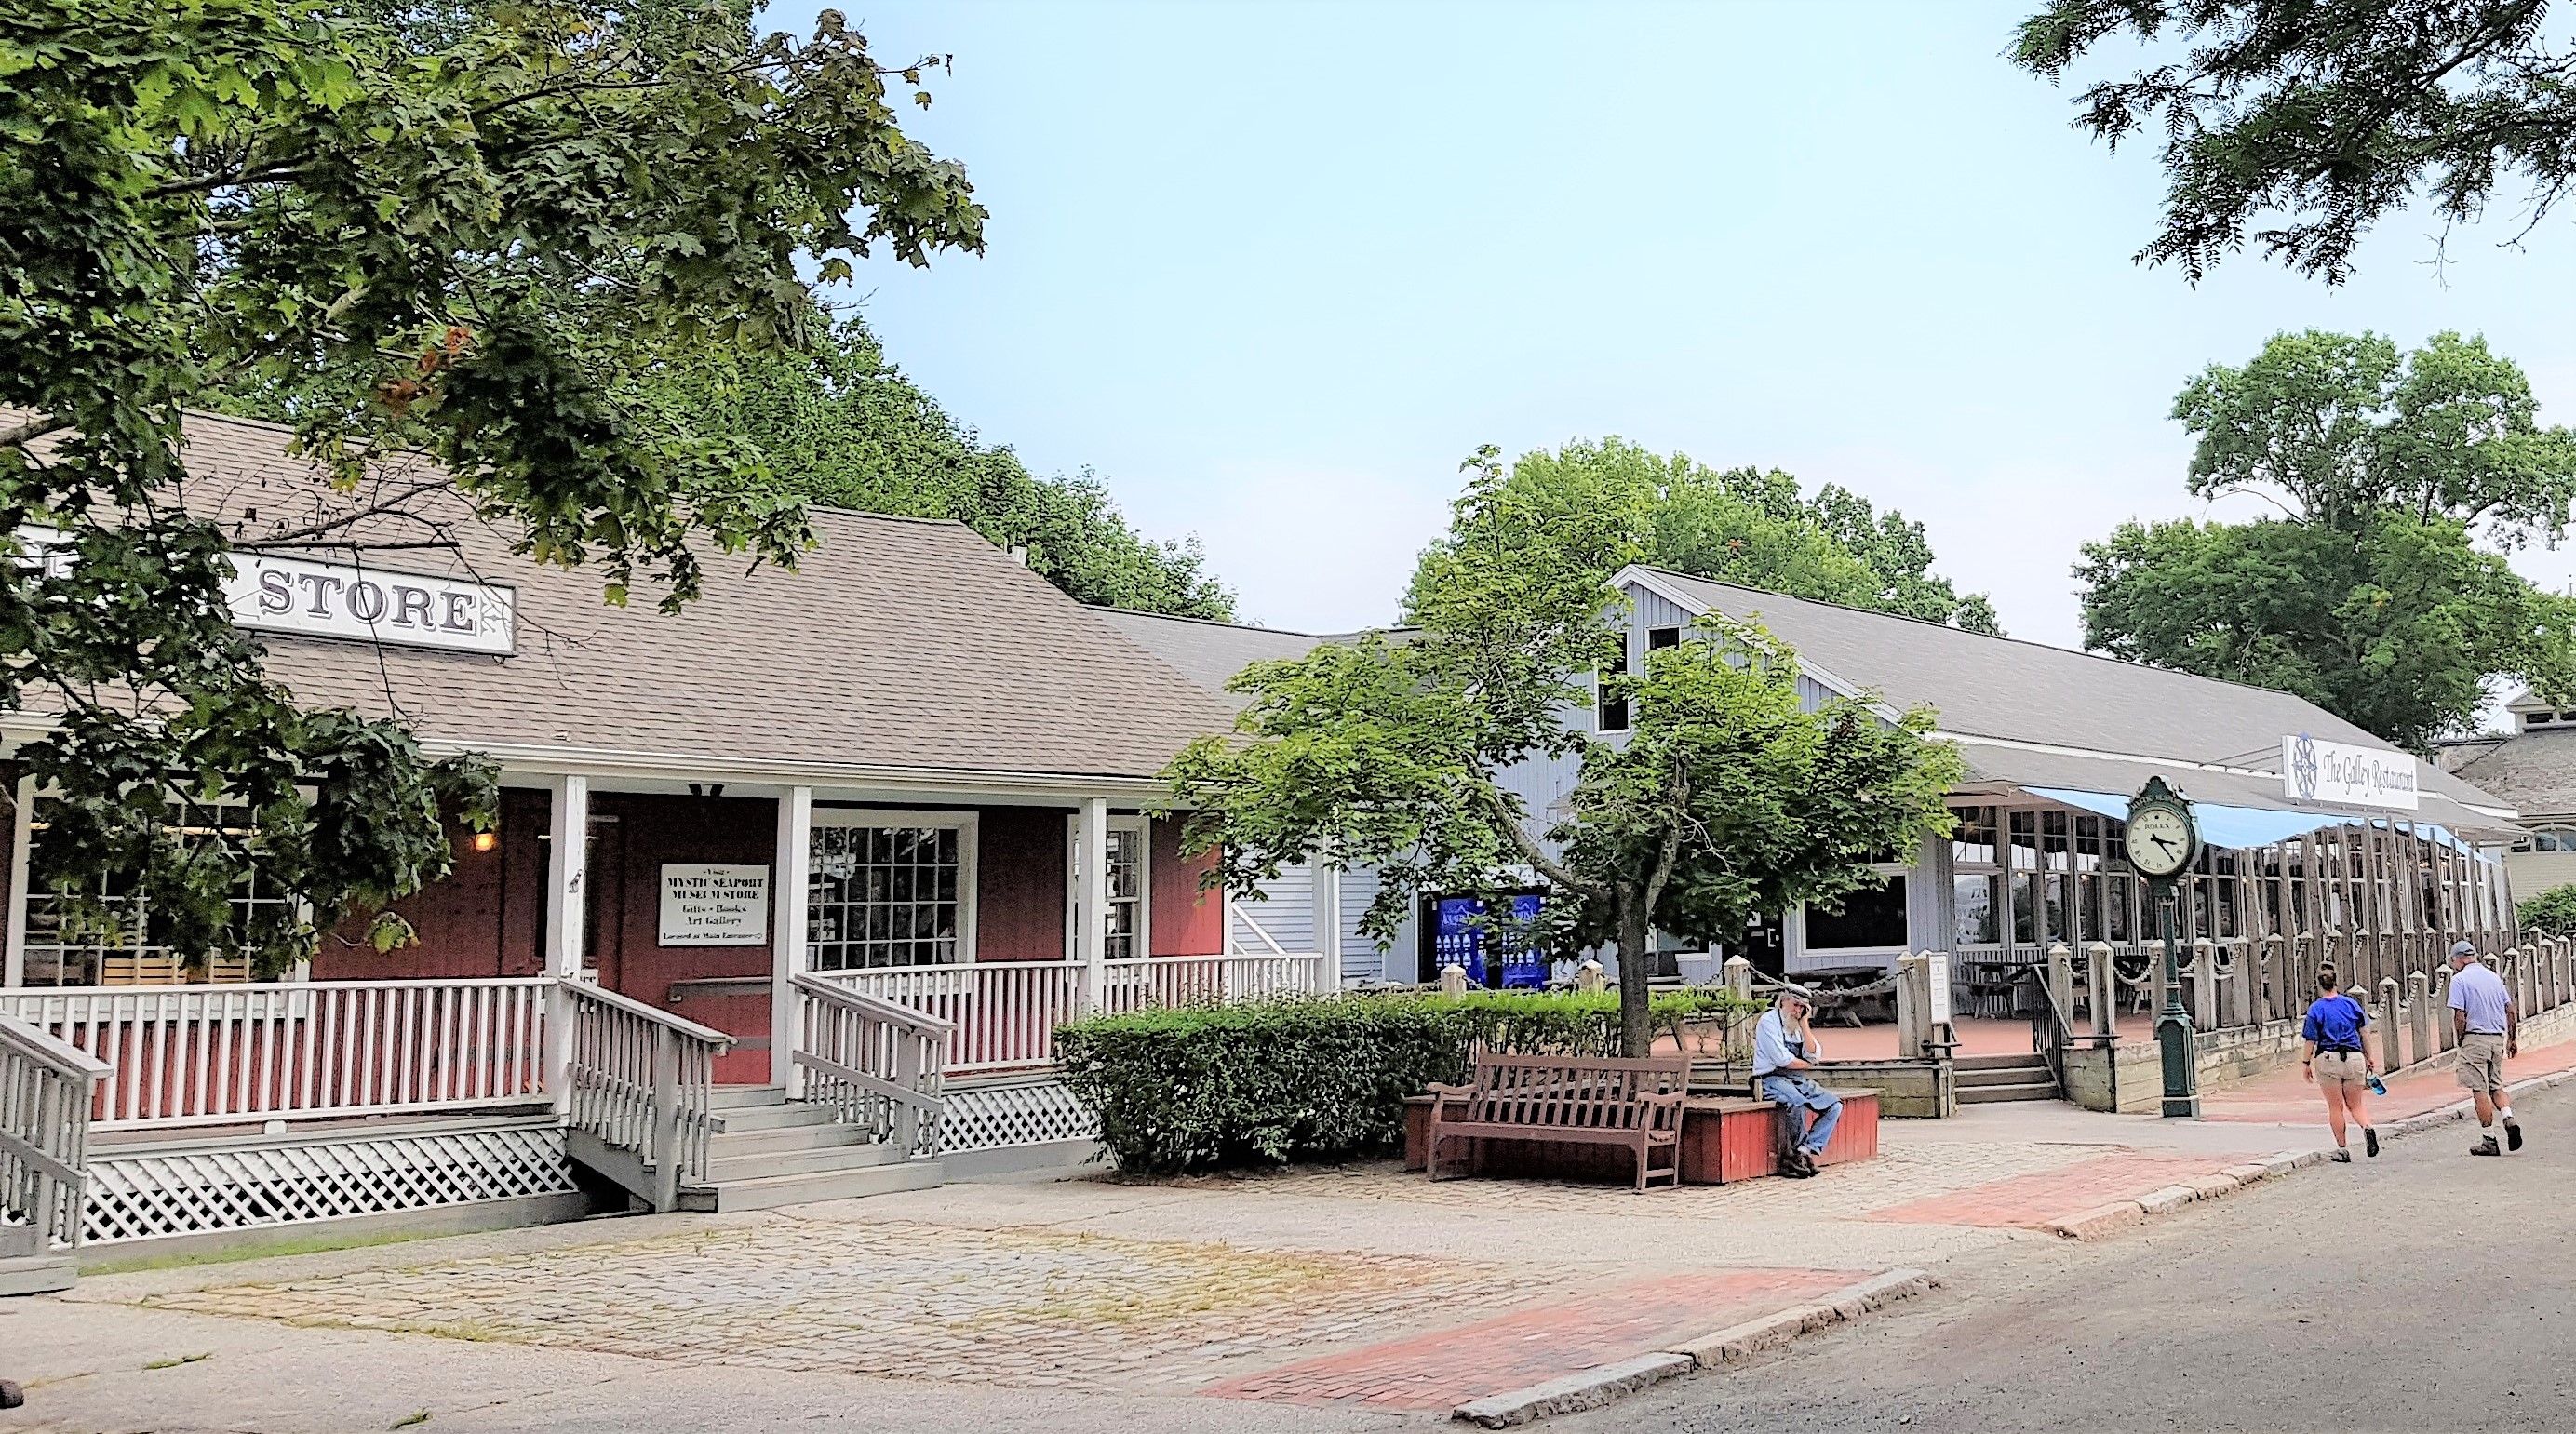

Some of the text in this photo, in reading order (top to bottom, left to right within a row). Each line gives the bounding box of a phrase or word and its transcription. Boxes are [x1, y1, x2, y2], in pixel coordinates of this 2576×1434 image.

[259, 569, 476, 637] STORE
[2323, 749, 2413, 797] The Galley Restaurant
[666, 878, 764, 888] MYSTIC SEAPORT
[672, 890, 759, 899] MUSEUM STORE
[682, 904, 747, 913] Gifts Books
[685, 916, 742, 927] Art Gallery
